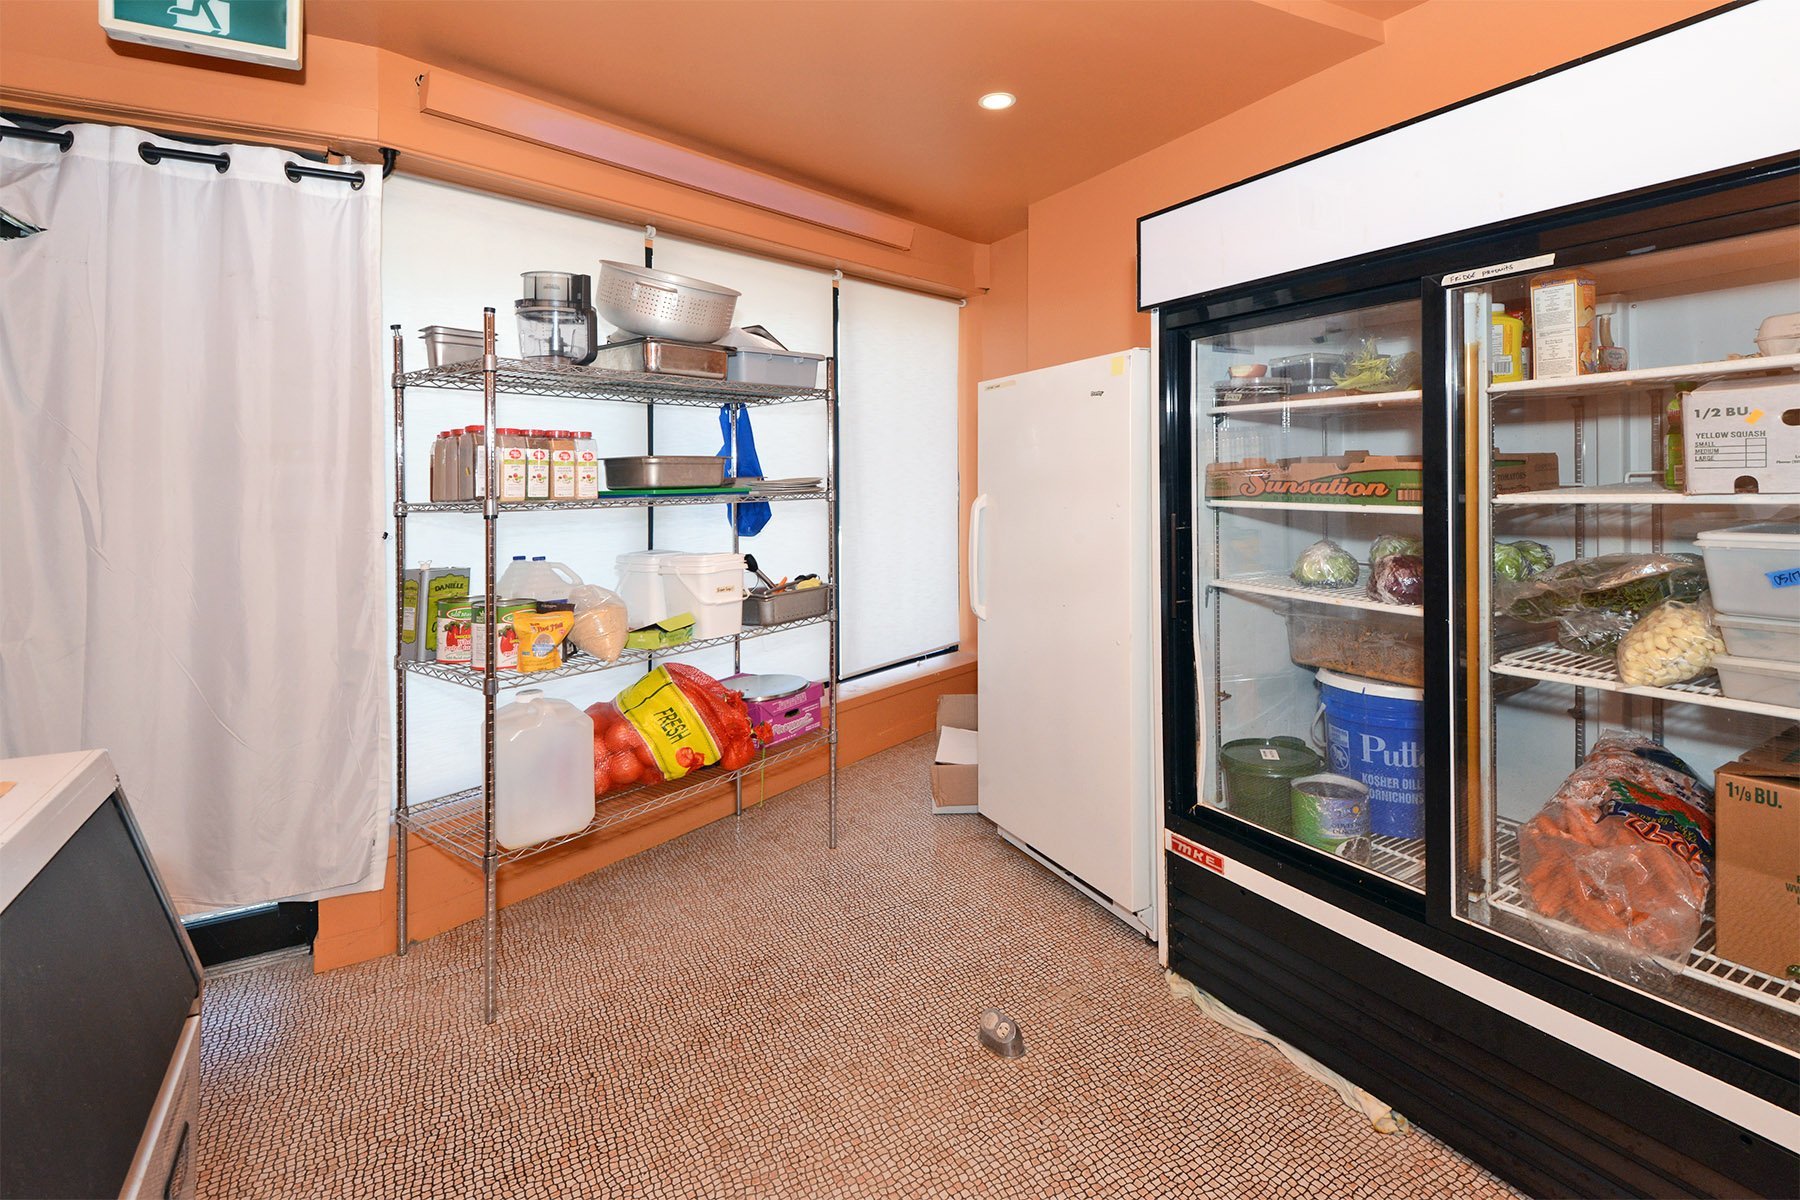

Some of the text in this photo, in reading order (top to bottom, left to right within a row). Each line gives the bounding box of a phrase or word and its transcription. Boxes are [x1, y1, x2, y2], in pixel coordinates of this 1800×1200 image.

[1694, 407, 1721, 420] 1/2
[1695, 430, 1766, 439] YELLOW SQUASH
[1240, 472, 1391, 497] Sunsation
[653, 707, 691, 744] FRESH
[1359, 732, 1424, 768] Putt
[1361, 772, 1399, 789] KOSHER
[1754, 787, 1783, 809] BU.
